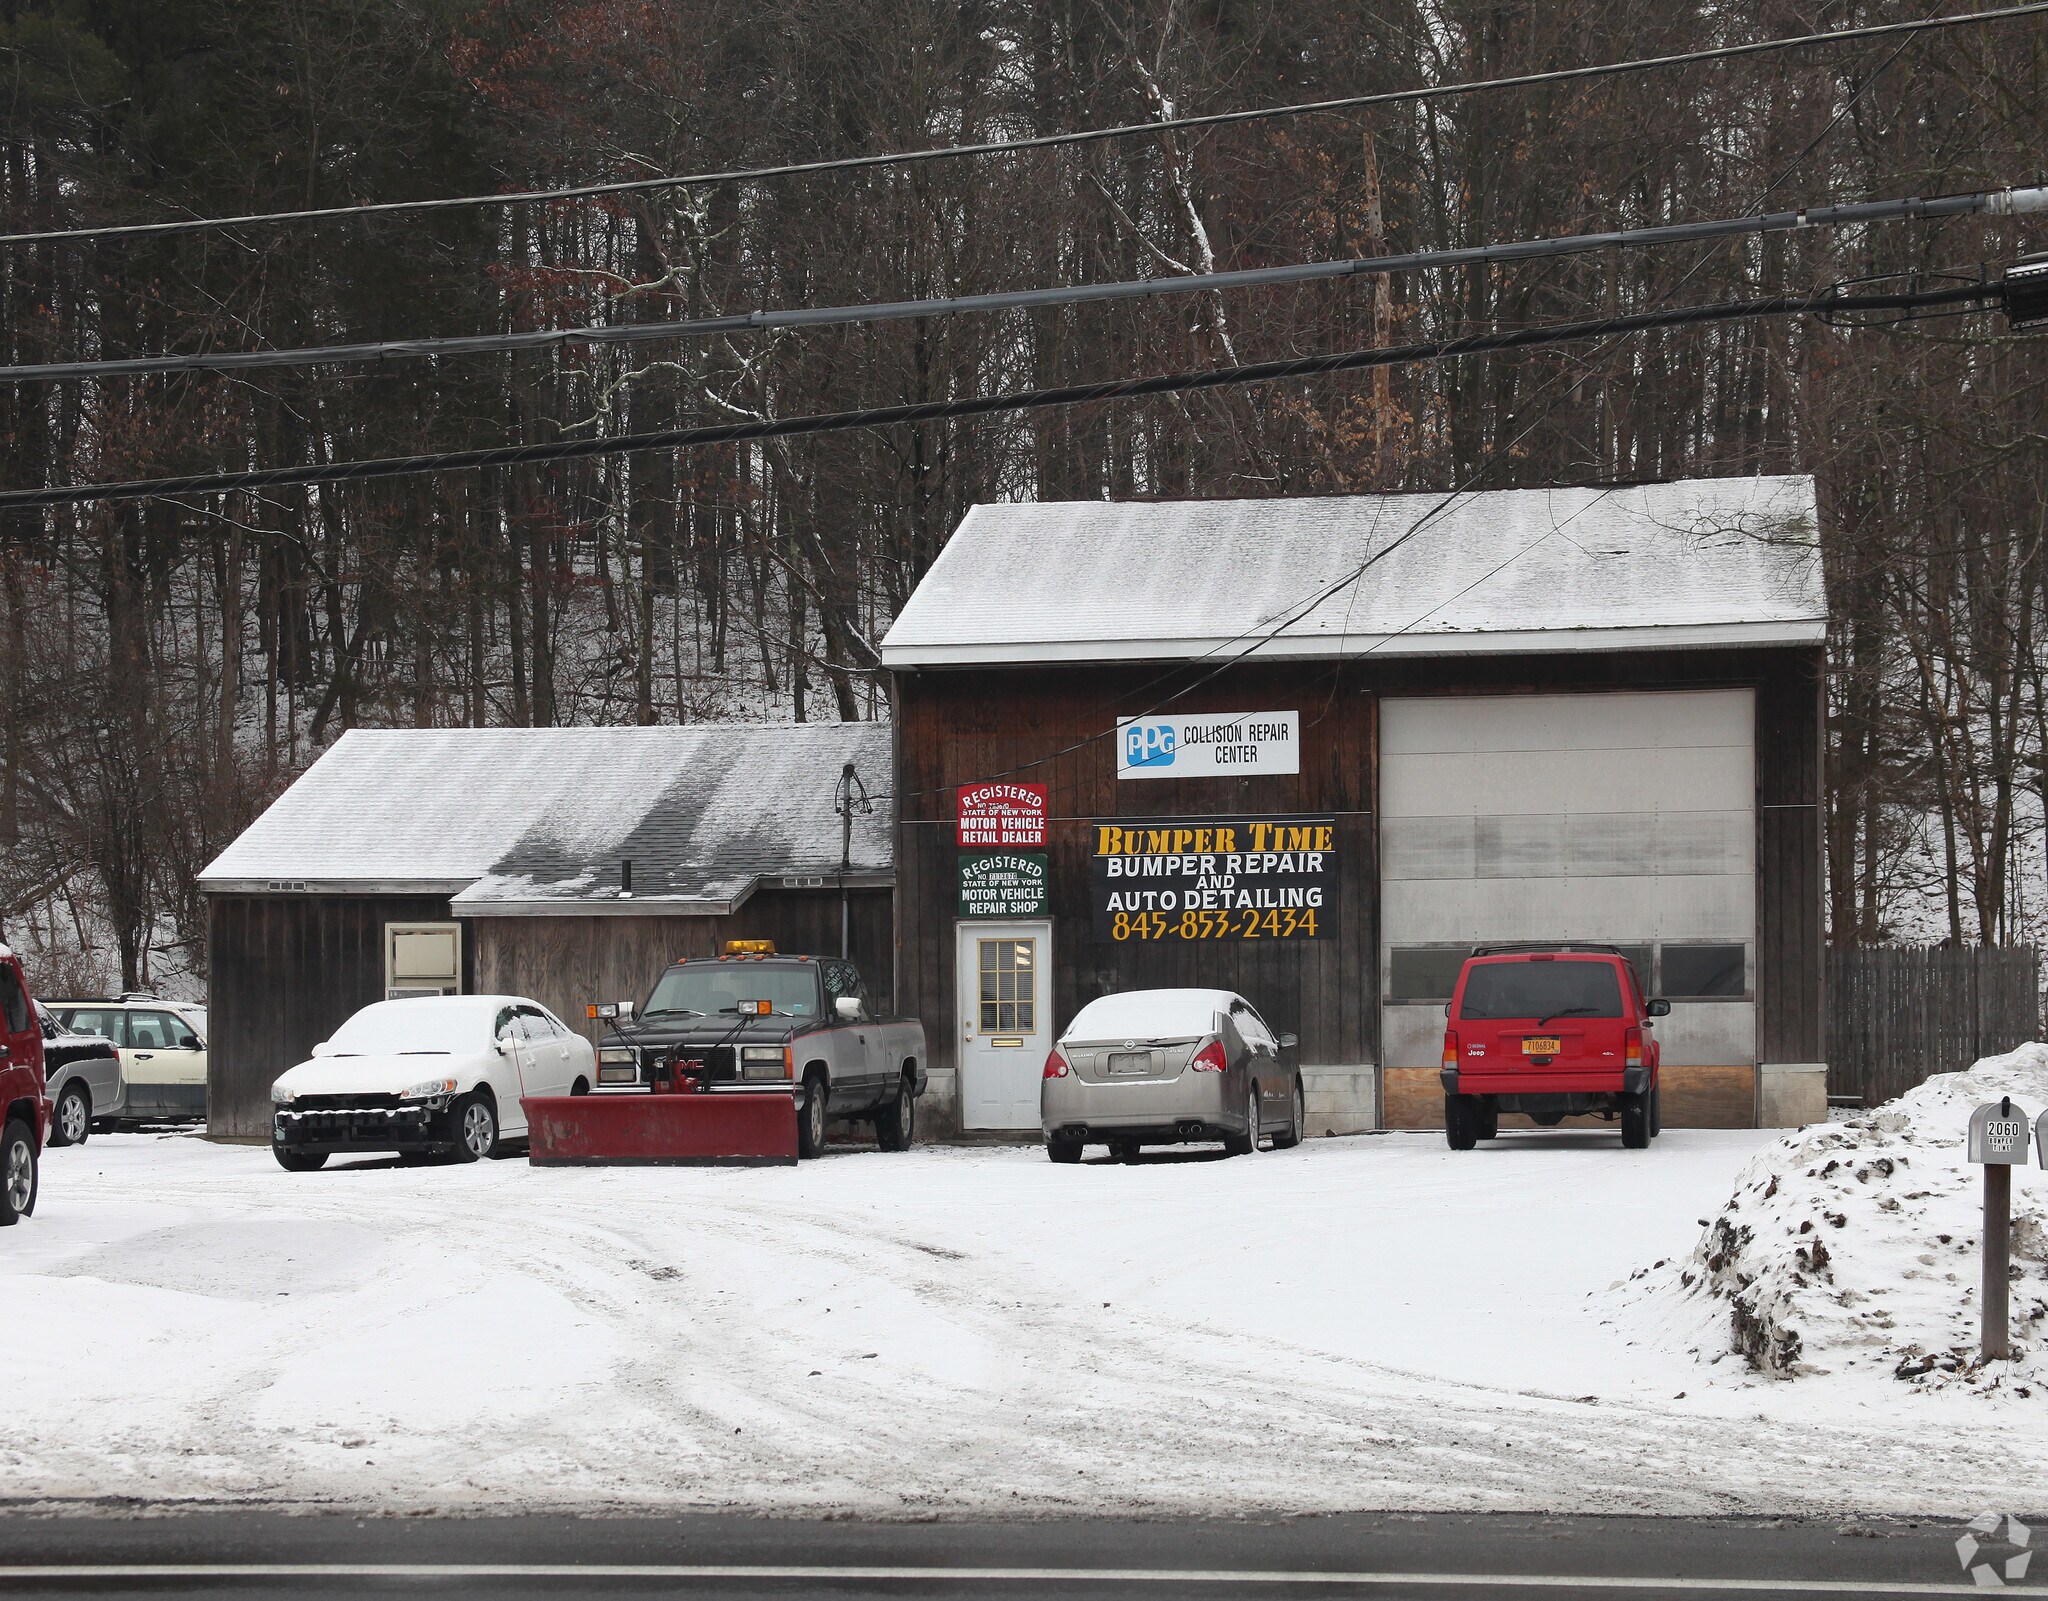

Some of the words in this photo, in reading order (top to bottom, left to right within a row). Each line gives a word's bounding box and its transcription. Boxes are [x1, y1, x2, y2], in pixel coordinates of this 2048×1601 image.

[1128, 725, 1175, 760] PPG
[1184, 725, 1242, 744] COLLISION
[1249, 723, 1289, 742] REPAIR
[1215, 745, 1258, 763] CENTER
[962, 785, 1042, 808] REGISTERED
[960, 817, 997, 830] MOTOR
[1001, 817, 1045, 830] VEHICLE
[962, 831, 999, 843] RETAIL
[1002, 831, 1042, 843] DEALER
[962, 856, 1042, 879] REGISTERED
[1106, 855, 1216, 877] BUMPER
[1226, 853, 1324, 874] REPAIR
[1195, 875, 1235, 889] AND
[962, 888, 997, 900] MOTOR
[1000, 887, 1044, 899] VEHICLE
[1106, 890, 1177, 911] AUTO
[1184, 887, 1323, 910] DETAILING
[969, 901, 1007, 914] REPAIR
[1010, 901, 1039, 913] SHOP
[1112, 908, 1319, 940] 845-853-2434
[1527, 1041, 1555, 1050] 7106834
[1988, 1122, 2019, 1136] 2060
